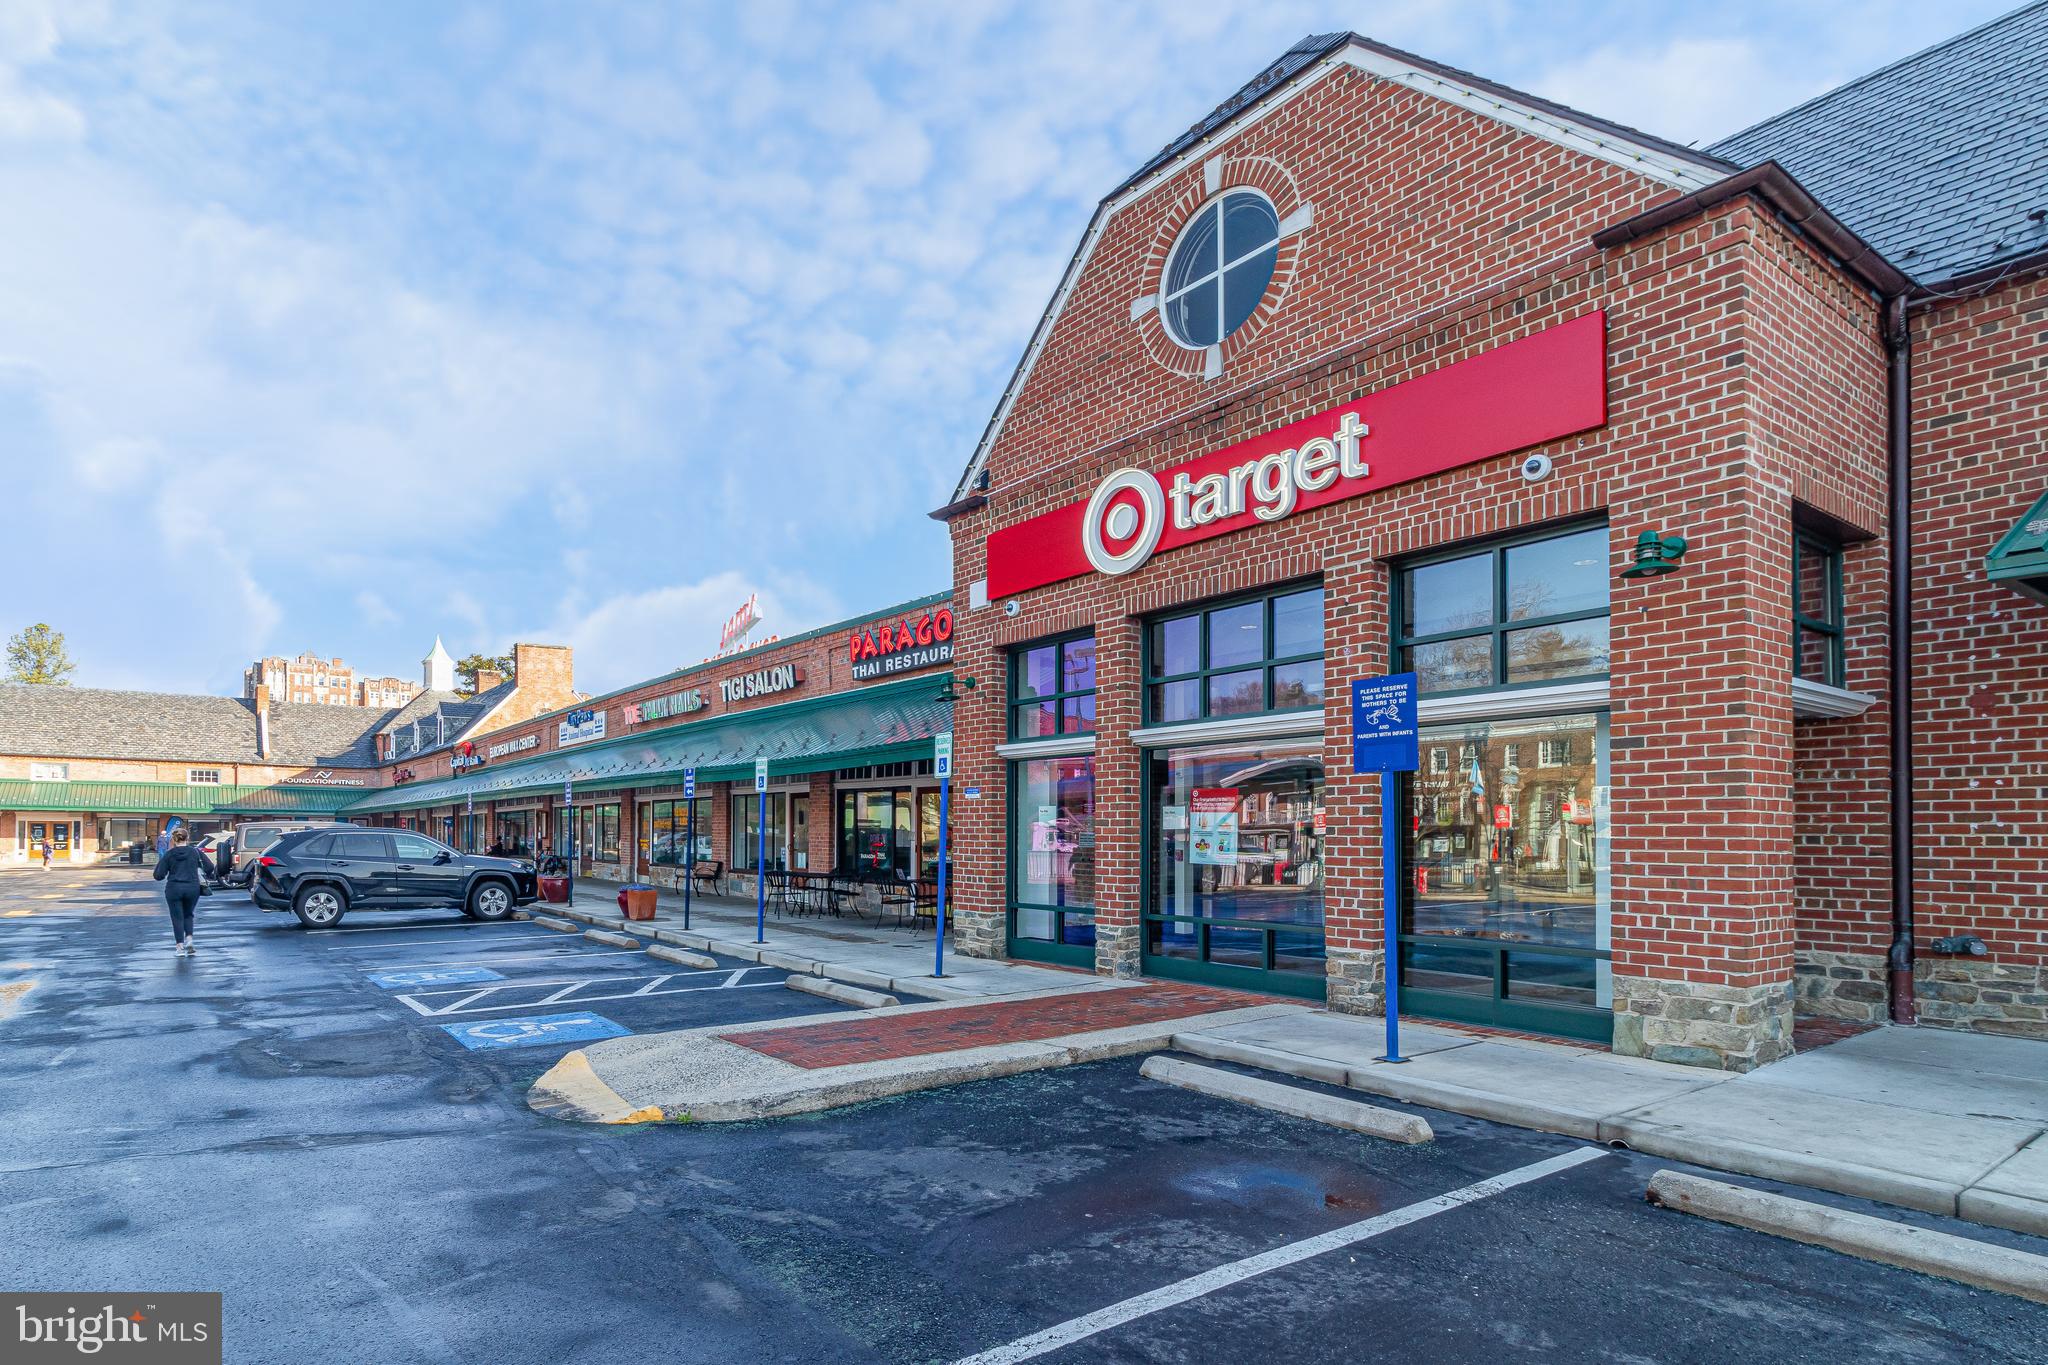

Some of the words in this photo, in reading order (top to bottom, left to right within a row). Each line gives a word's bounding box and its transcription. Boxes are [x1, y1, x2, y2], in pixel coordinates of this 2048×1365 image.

[1169, 412, 1369, 529] target
[850, 608, 953, 662] PARAGO
[852, 661, 880, 679] THAI
[886, 645, 954, 672] RESTAUR
[719, 676, 745, 702] TIGI
[745, 664, 795, 697] SALON
[1382, 684, 1408, 692] RESERVE
[669, 688, 701, 716] NAILS
[1361, 700, 1387, 708] MOTHERS
[1357, 732, 1378, 740] PARENTS
